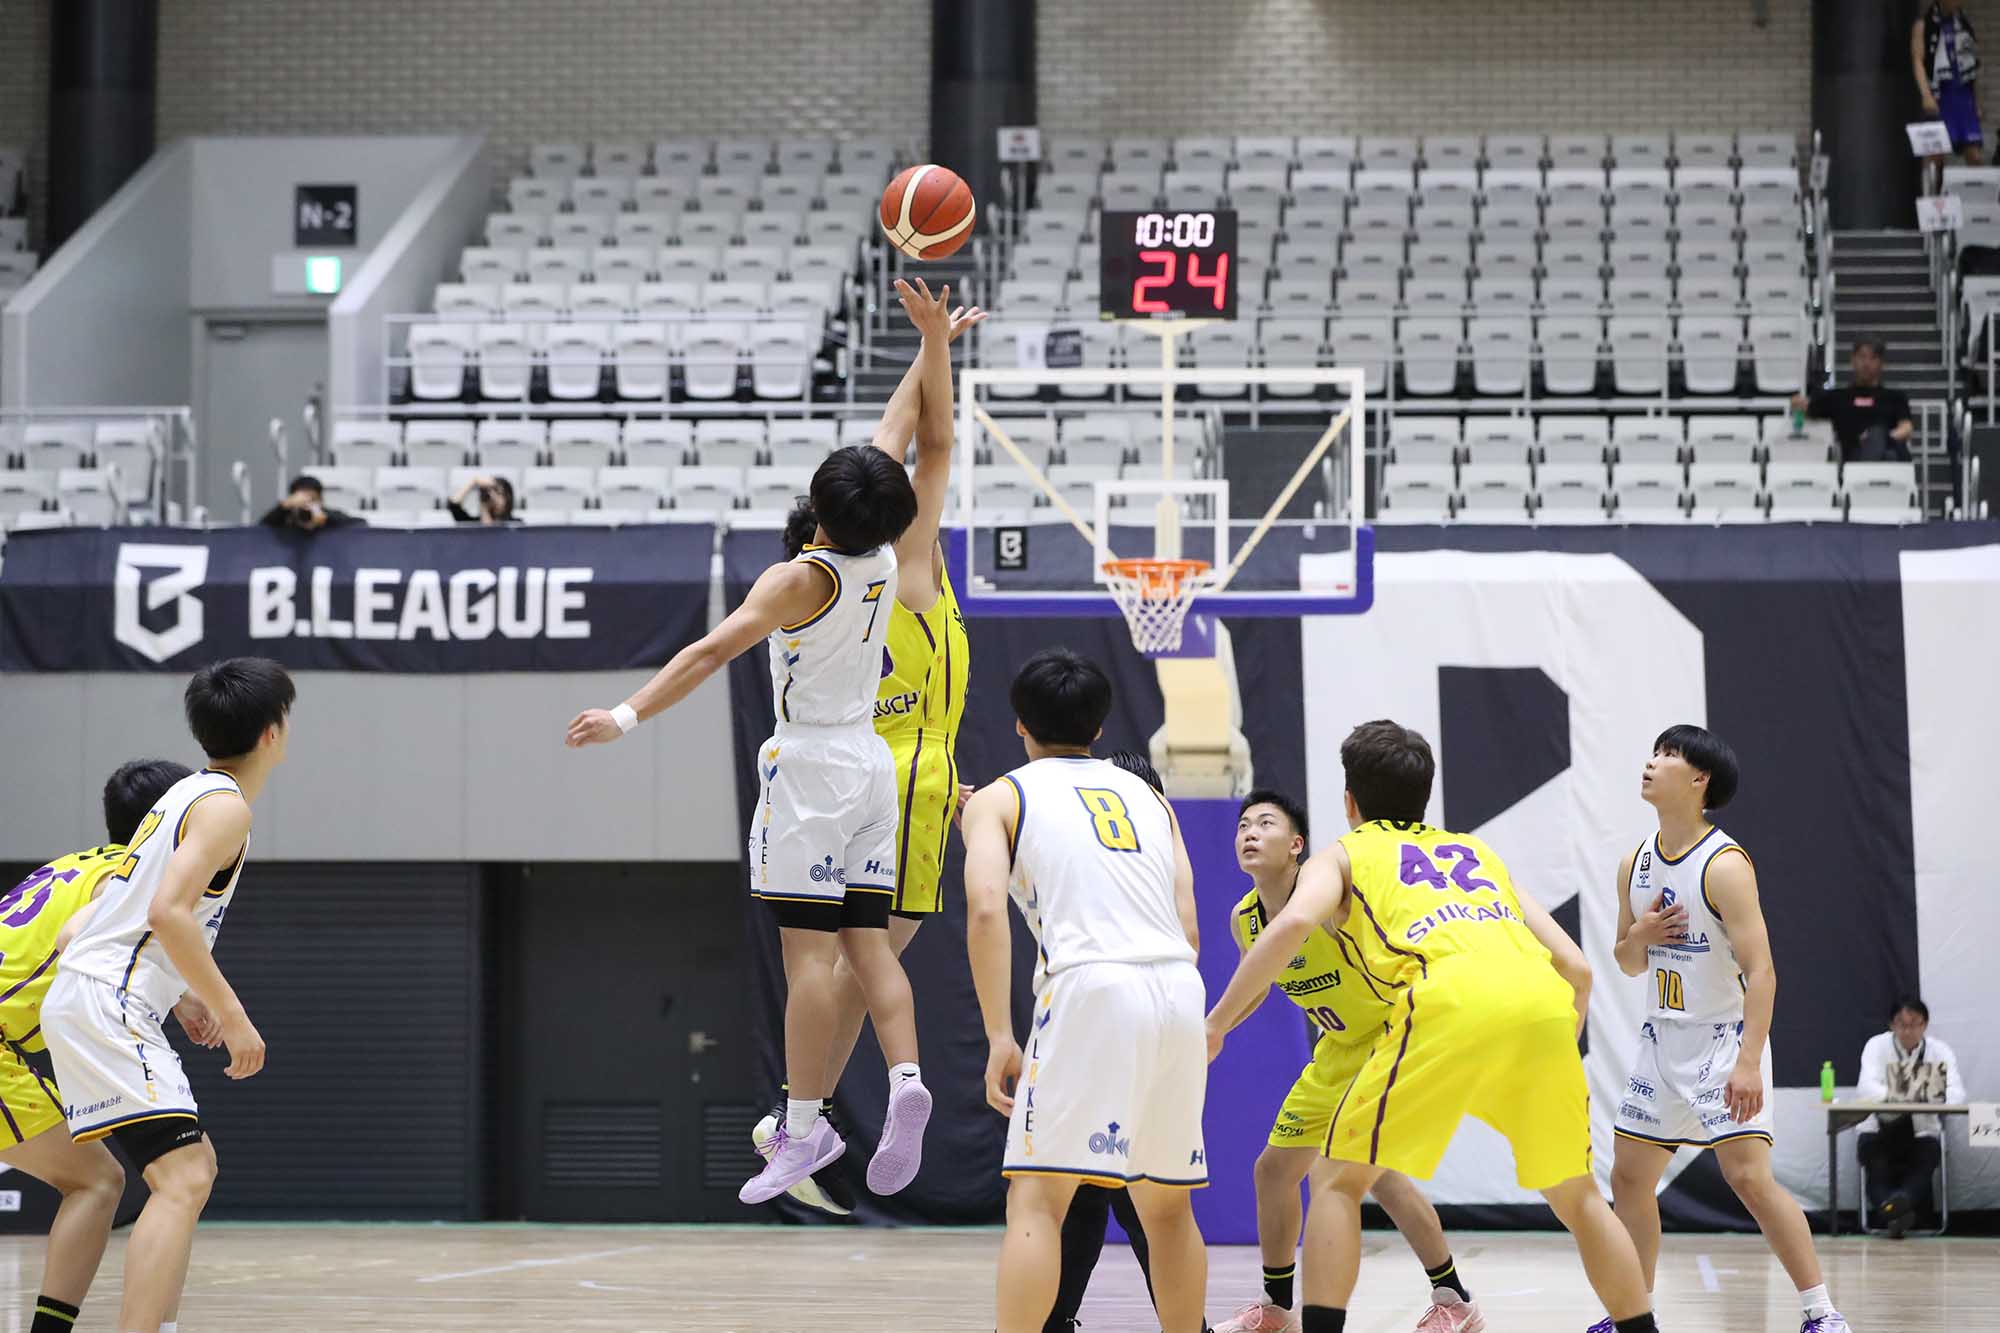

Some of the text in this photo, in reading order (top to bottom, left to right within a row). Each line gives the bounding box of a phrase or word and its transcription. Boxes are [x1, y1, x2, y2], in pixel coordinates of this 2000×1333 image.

[300, 201, 352, 229] N-2
[1135, 213, 1215, 247] 10:00
[1132, 251, 1229, 312] 24
[249, 566, 594, 640] B.LEAGUE
[862, 579, 887, 643] 7
[873, 690, 921, 719] UCH
[1073, 786, 1142, 854] 8
[1400, 844, 1498, 893] 42
[1656, 968, 1685, 1011] 10
[1306, 1006, 1346, 1031] 10
